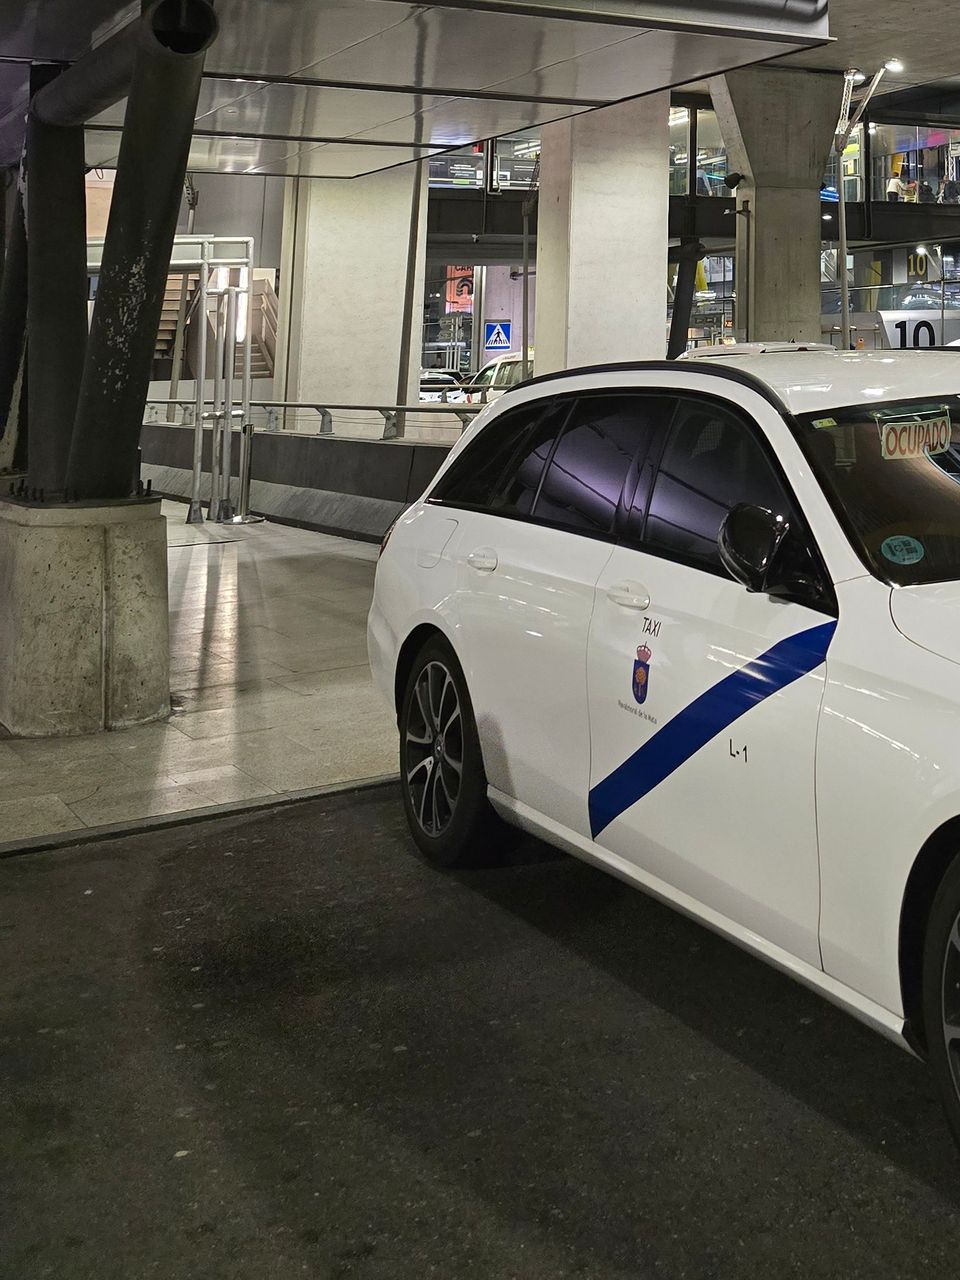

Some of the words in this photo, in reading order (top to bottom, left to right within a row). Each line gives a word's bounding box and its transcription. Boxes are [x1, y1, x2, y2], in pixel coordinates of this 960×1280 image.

[908, 254, 926, 276] 10
[895, 320, 935, 347] 10
[886, 420, 947, 456] OCUPADO
[642, 617, 661, 637] TAXI
